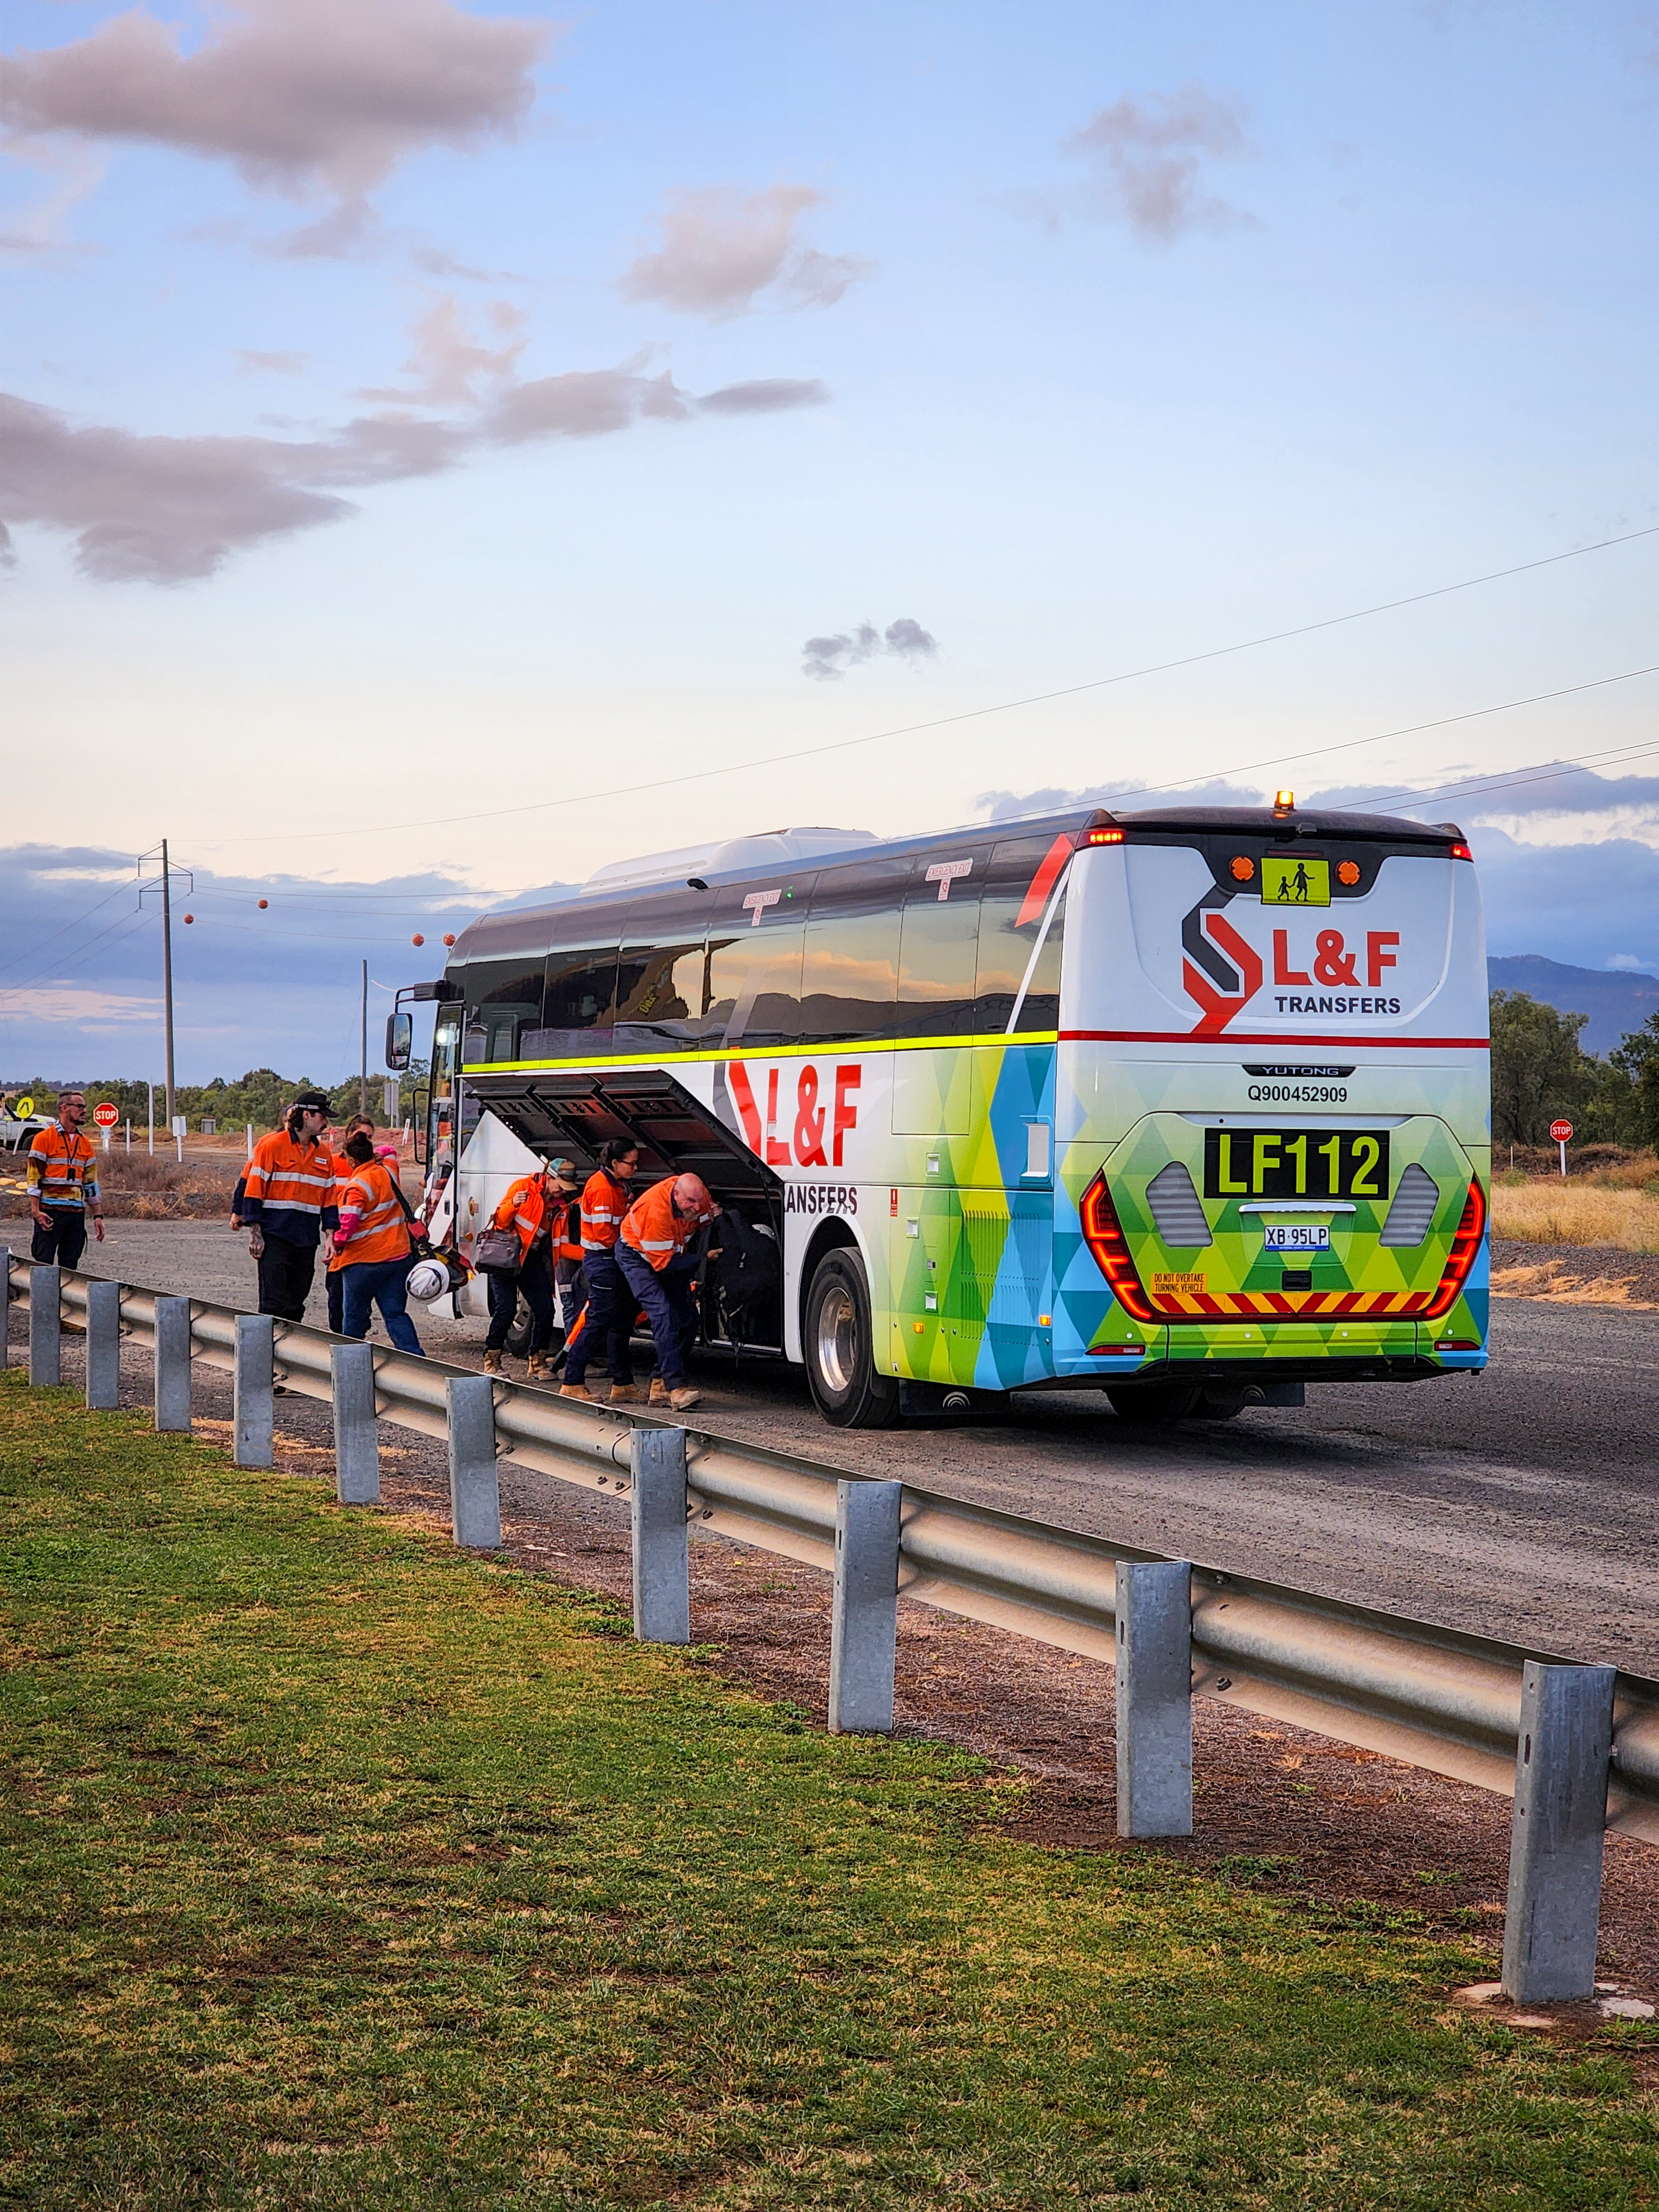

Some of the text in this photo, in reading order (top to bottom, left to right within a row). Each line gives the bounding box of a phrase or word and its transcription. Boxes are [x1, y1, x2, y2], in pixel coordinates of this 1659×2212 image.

[1273, 929, 1400, 987] L&F
[1274, 997, 1401, 1014] TRANSFERS
[1262, 1067, 1339, 1075] YUTONG
[1248, 1085, 1348, 1102] Q900452909
[96, 1110, 116, 1120] STOP
[766, 1064, 862, 1167] L&F
[1552, 1126, 1571, 1135] STOP
[1219, 1134, 1380, 1194] LF112
[785, 1185, 858, 1215] ANSFERS
[1154, 1274, 1204, 1283] DO NOT OVERTAKE
[1155, 1284, 1204, 1292] TURNING VEHICLE
